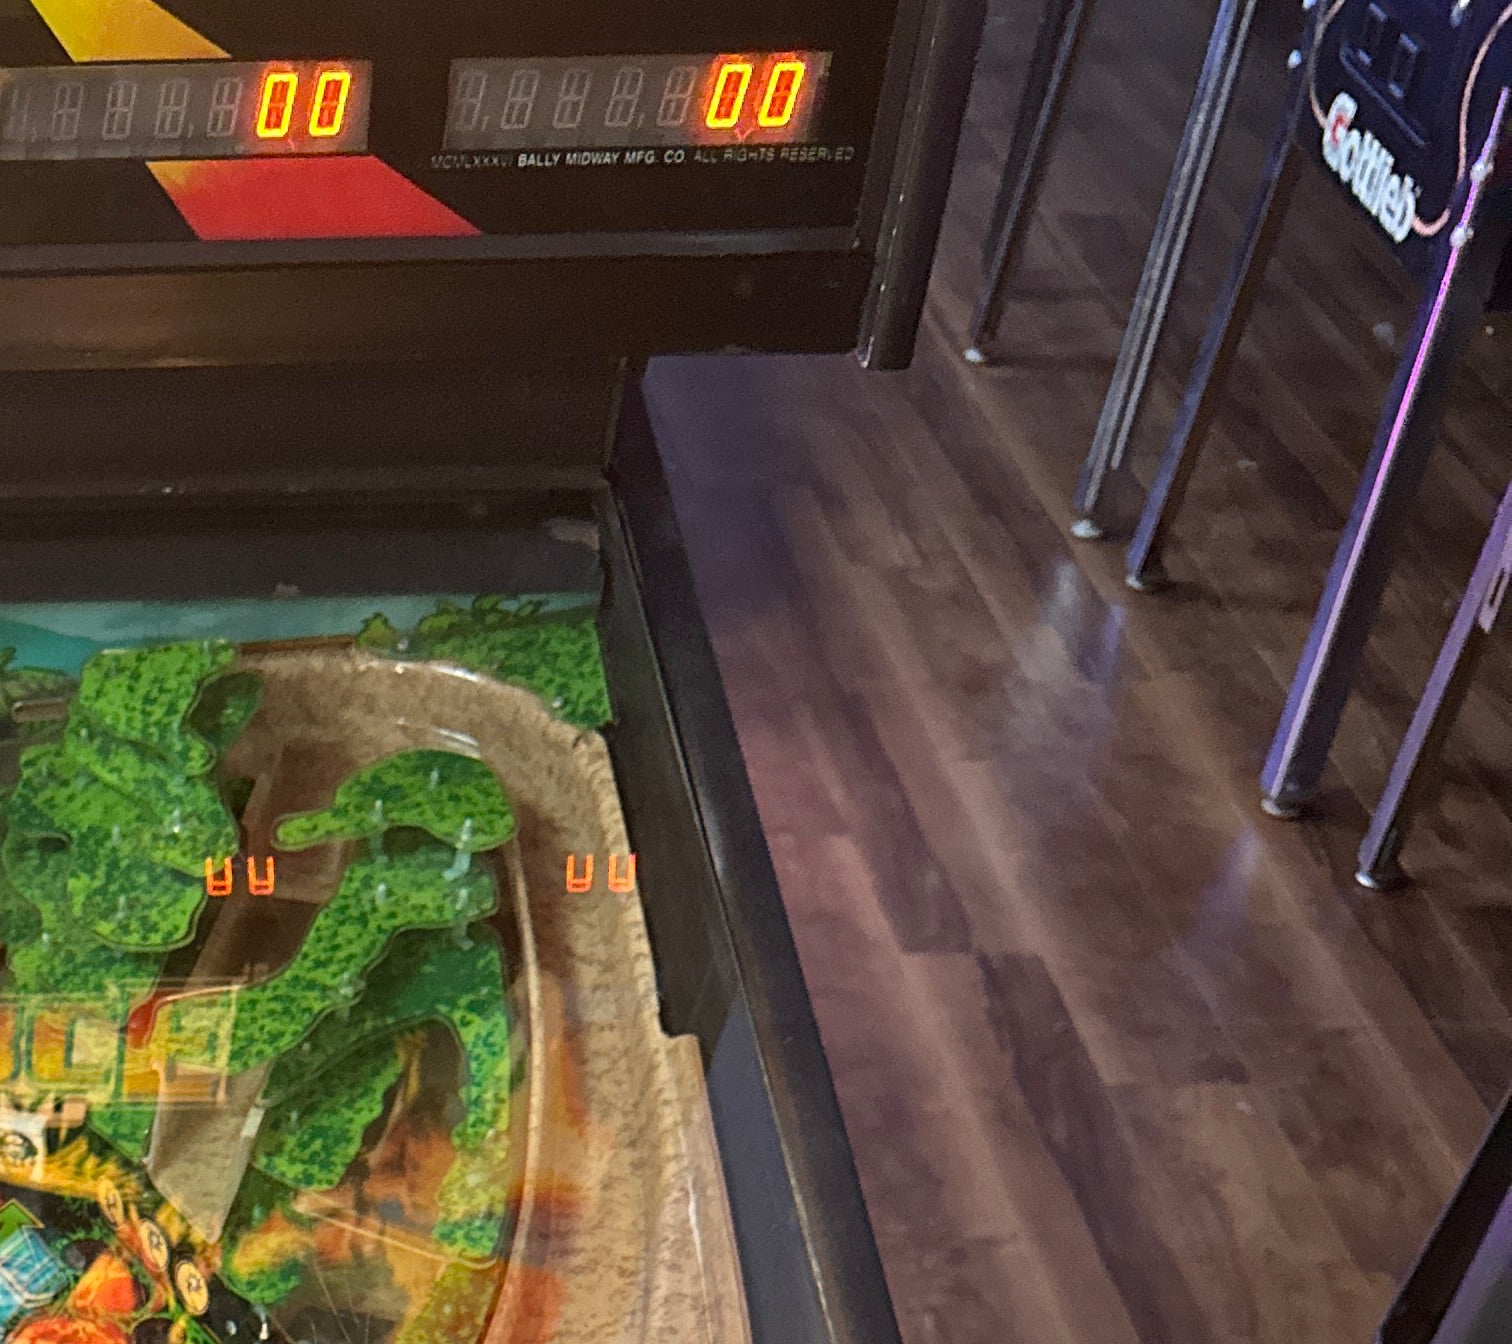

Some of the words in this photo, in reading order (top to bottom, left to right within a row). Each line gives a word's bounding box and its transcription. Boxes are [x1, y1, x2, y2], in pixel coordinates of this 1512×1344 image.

[257, 71, 350, 138] 00
[706, 61, 805, 130] 00
[517, 153, 559, 167] BALLY
[565, 152, 620, 166] MIDWAY
